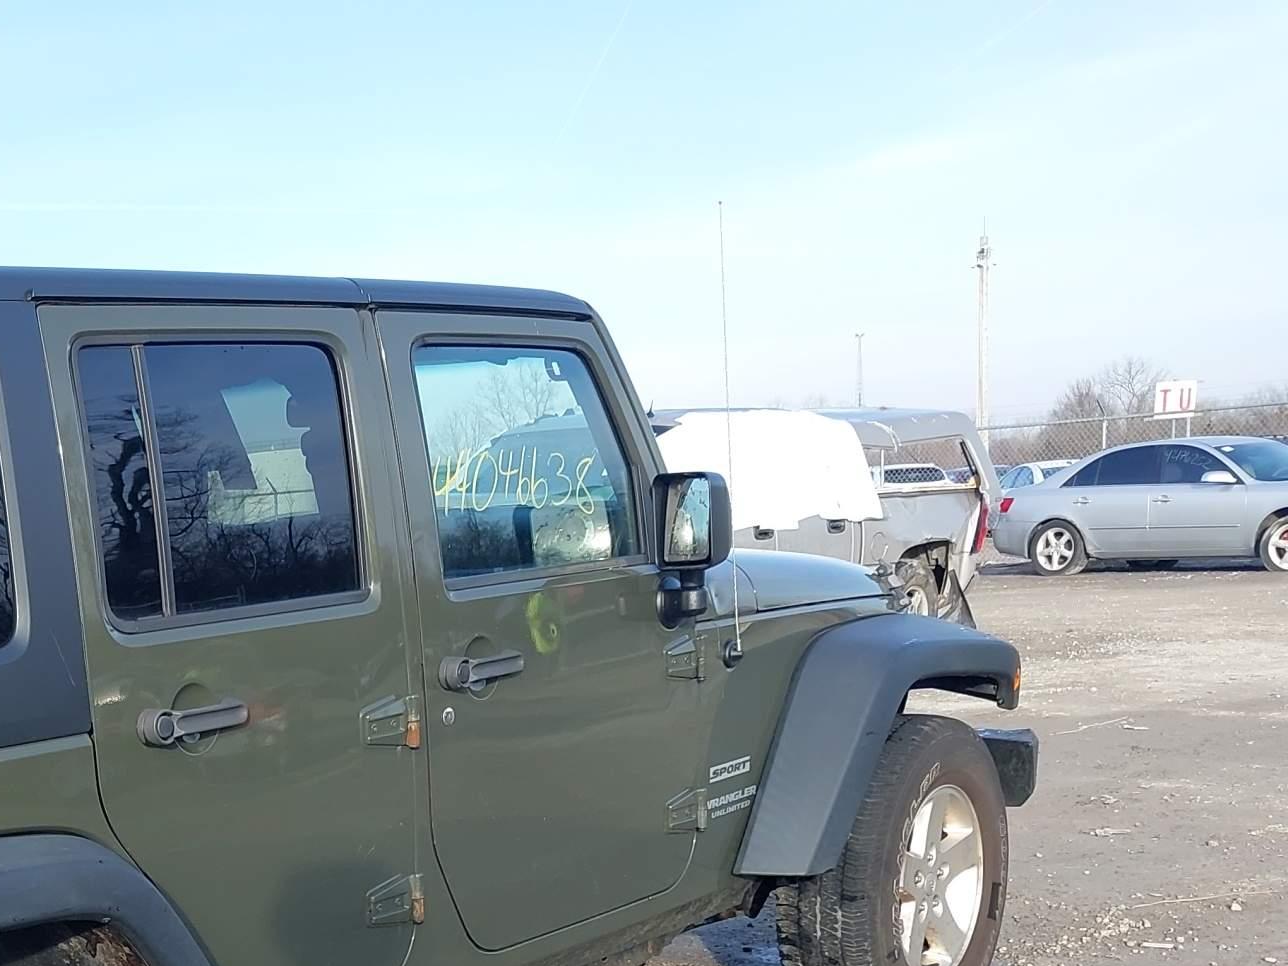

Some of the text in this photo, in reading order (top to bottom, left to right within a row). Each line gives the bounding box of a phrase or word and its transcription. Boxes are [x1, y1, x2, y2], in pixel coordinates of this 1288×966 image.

[433, 445, 599, 517] 44046638
[712, 760, 749, 779] SPORT
[711, 799, 751, 819] UNLIMITED
